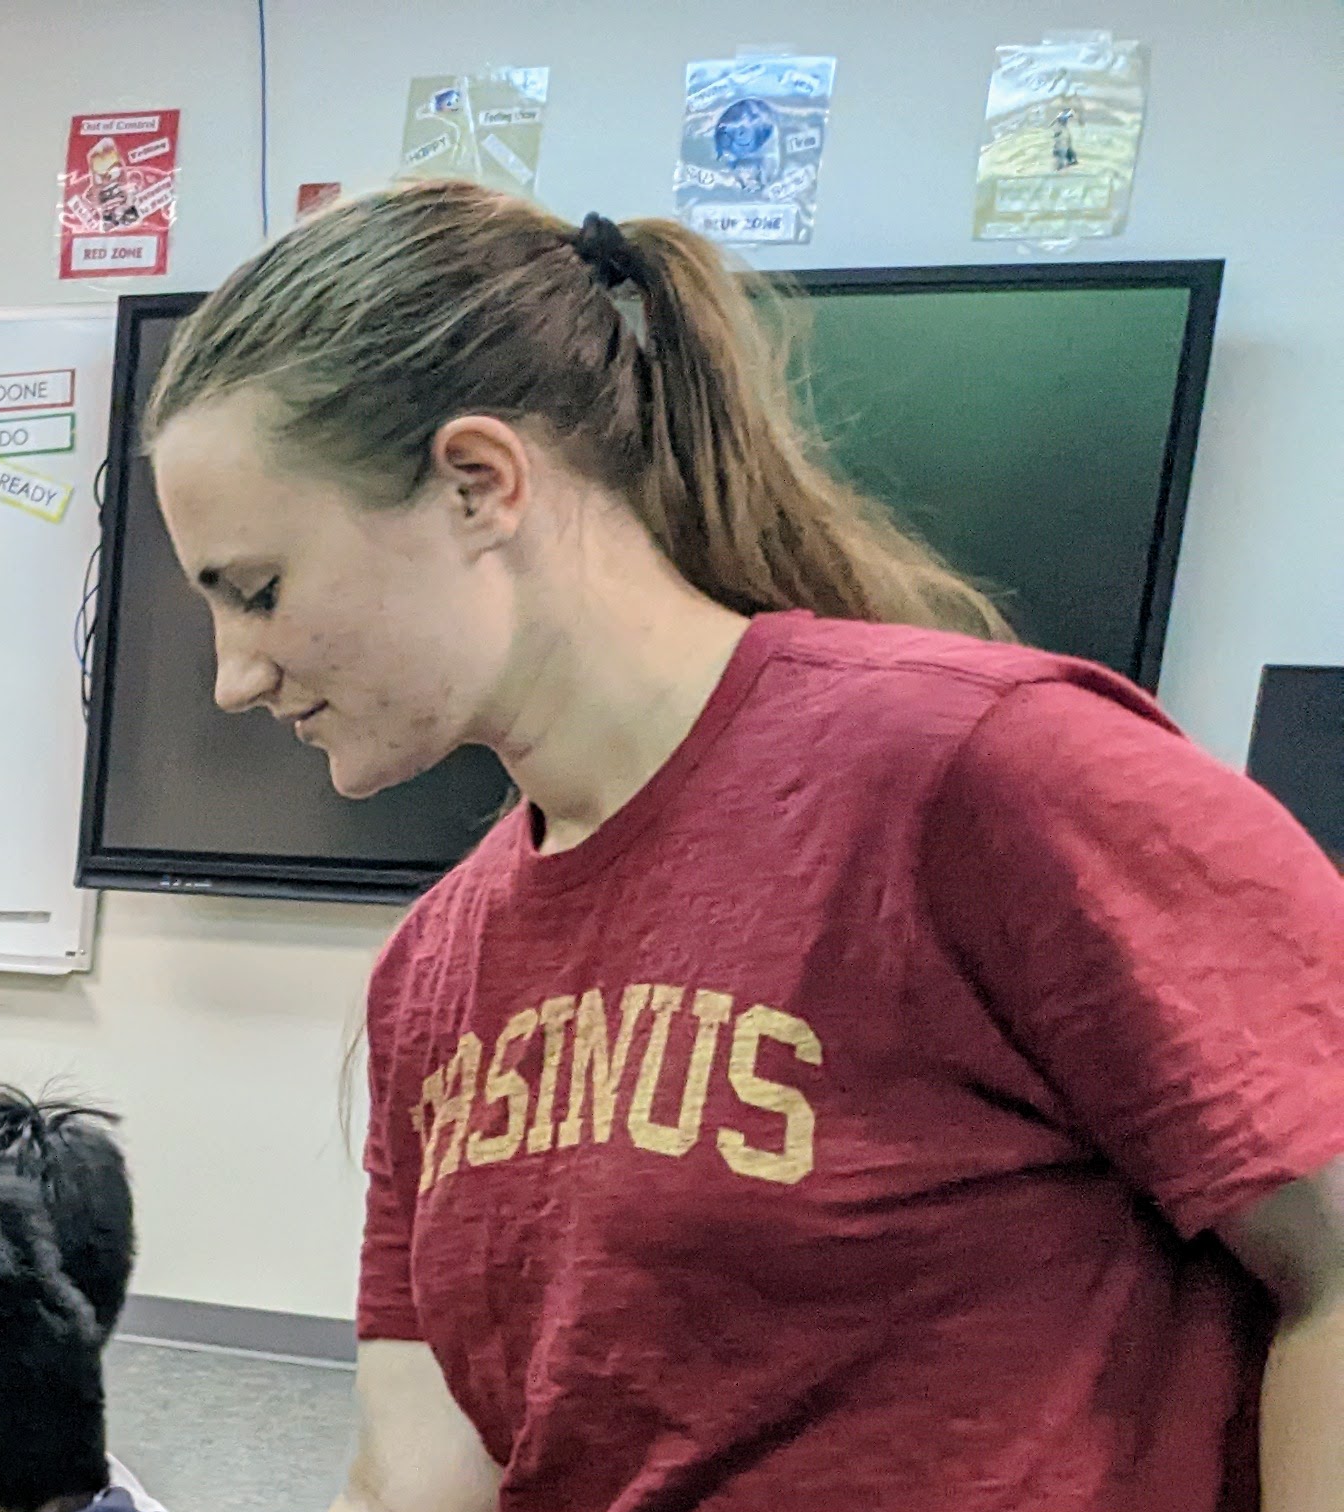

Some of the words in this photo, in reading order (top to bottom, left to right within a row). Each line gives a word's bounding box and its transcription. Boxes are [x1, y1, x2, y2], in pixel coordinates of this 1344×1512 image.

[84, 248, 107, 260] RED
[111, 247, 143, 260] ZONE
[408, 983, 823, 1195] RSINUS
